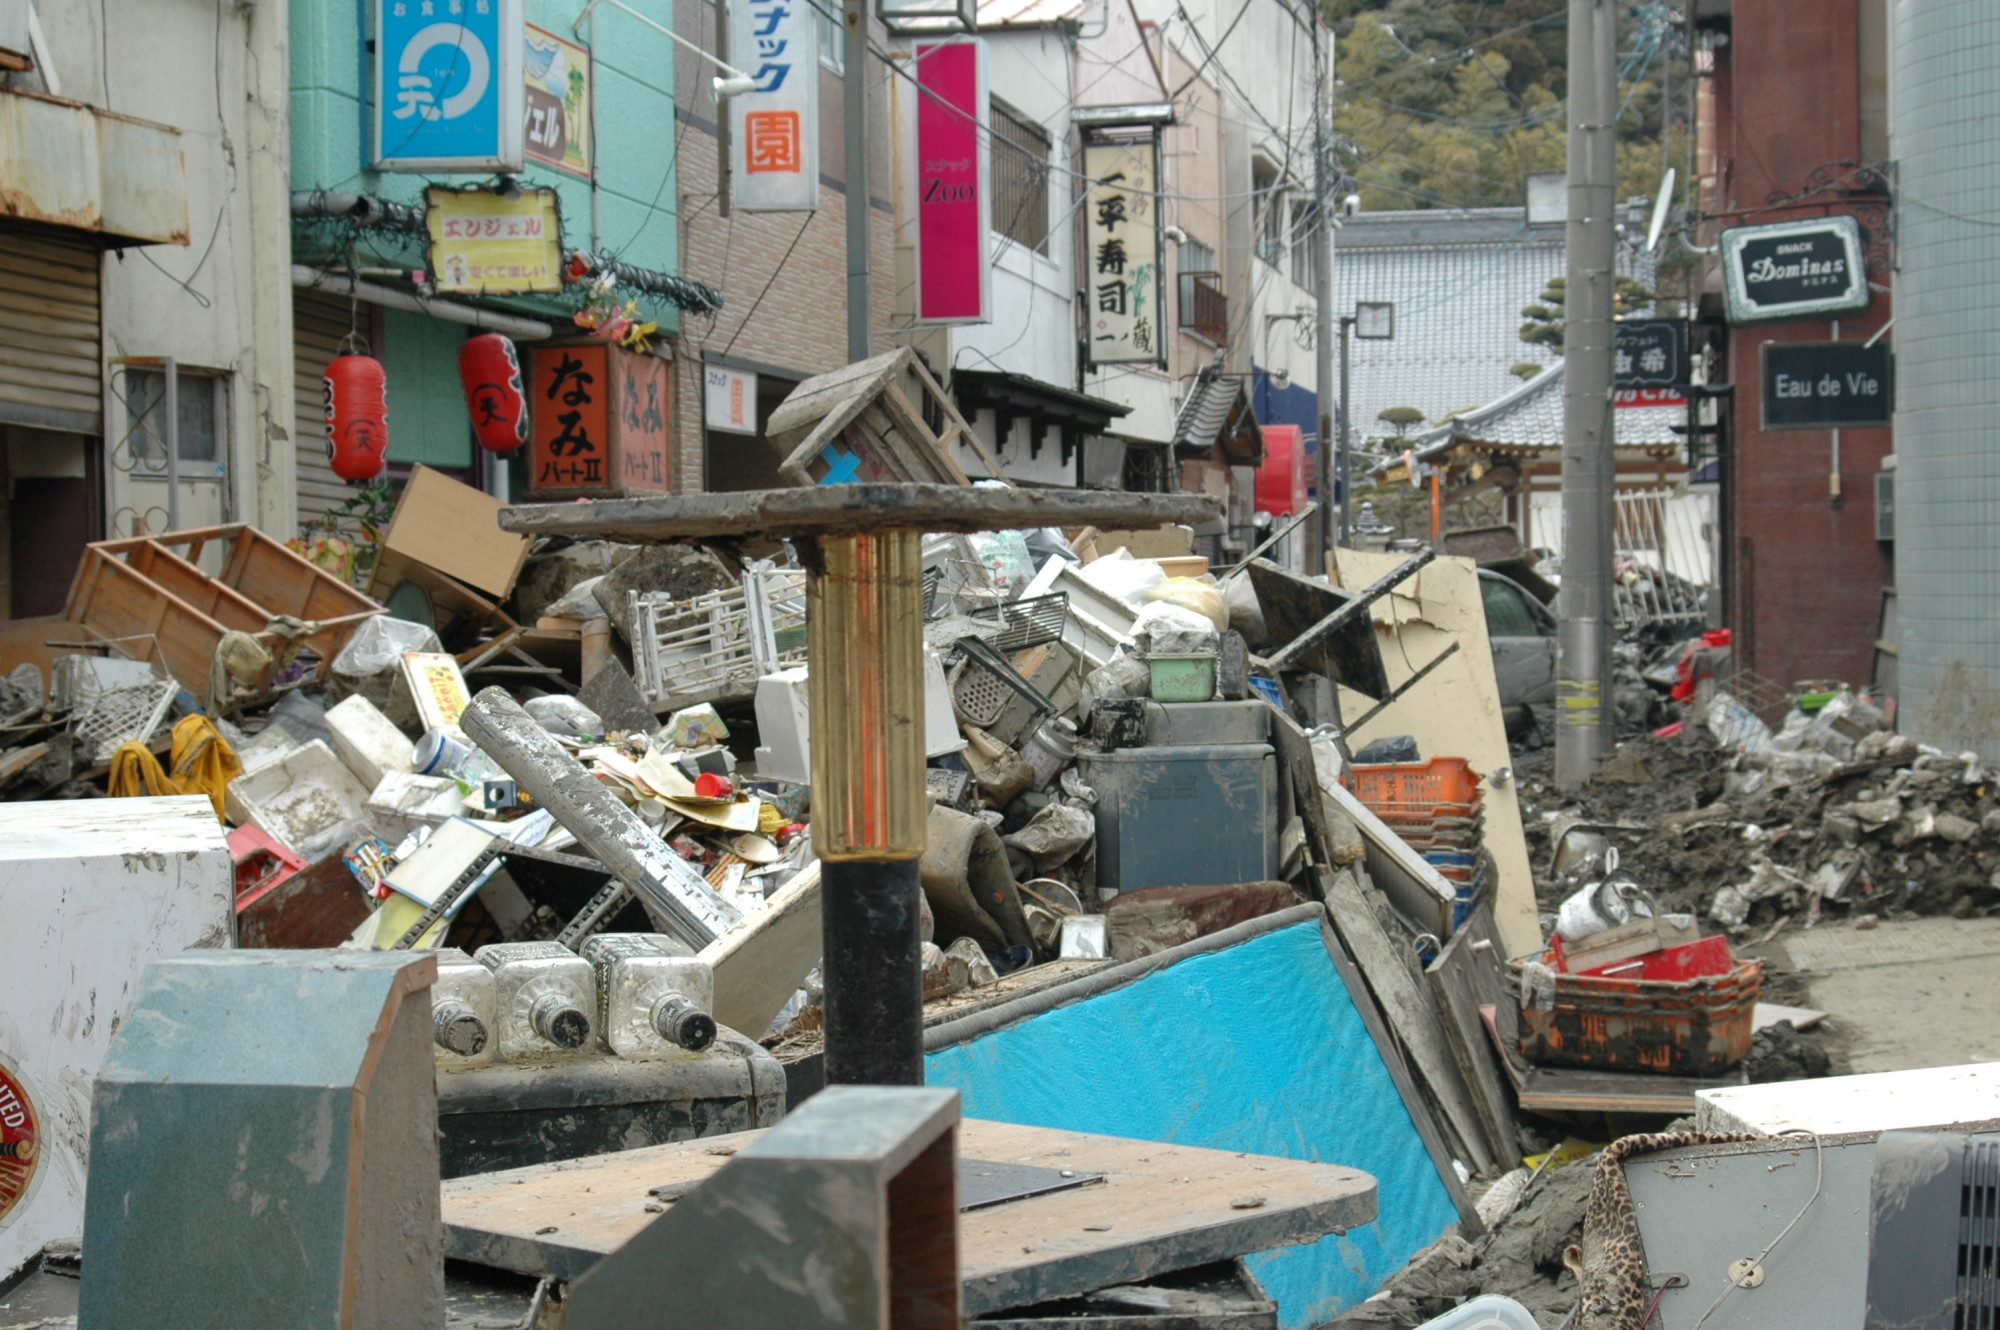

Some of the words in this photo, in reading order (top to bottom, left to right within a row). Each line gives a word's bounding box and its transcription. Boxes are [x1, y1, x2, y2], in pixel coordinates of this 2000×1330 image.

[749, 0, 791, 93] ナック
[444, 218, 541, 238] エンジェル
[1096, 172, 1128, 316] 一平寿司
[1776, 241, 1814, 255] SNACK
[470, 265, 545, 279] 安くて楽しい
[1747, 256, 1845, 284] Dominas
[1776, 373, 1812, 398] Eau
[1817, 373, 1841, 396] de
[1846, 371, 1879, 396] Vie
[546, 352, 595, 456] なみ
